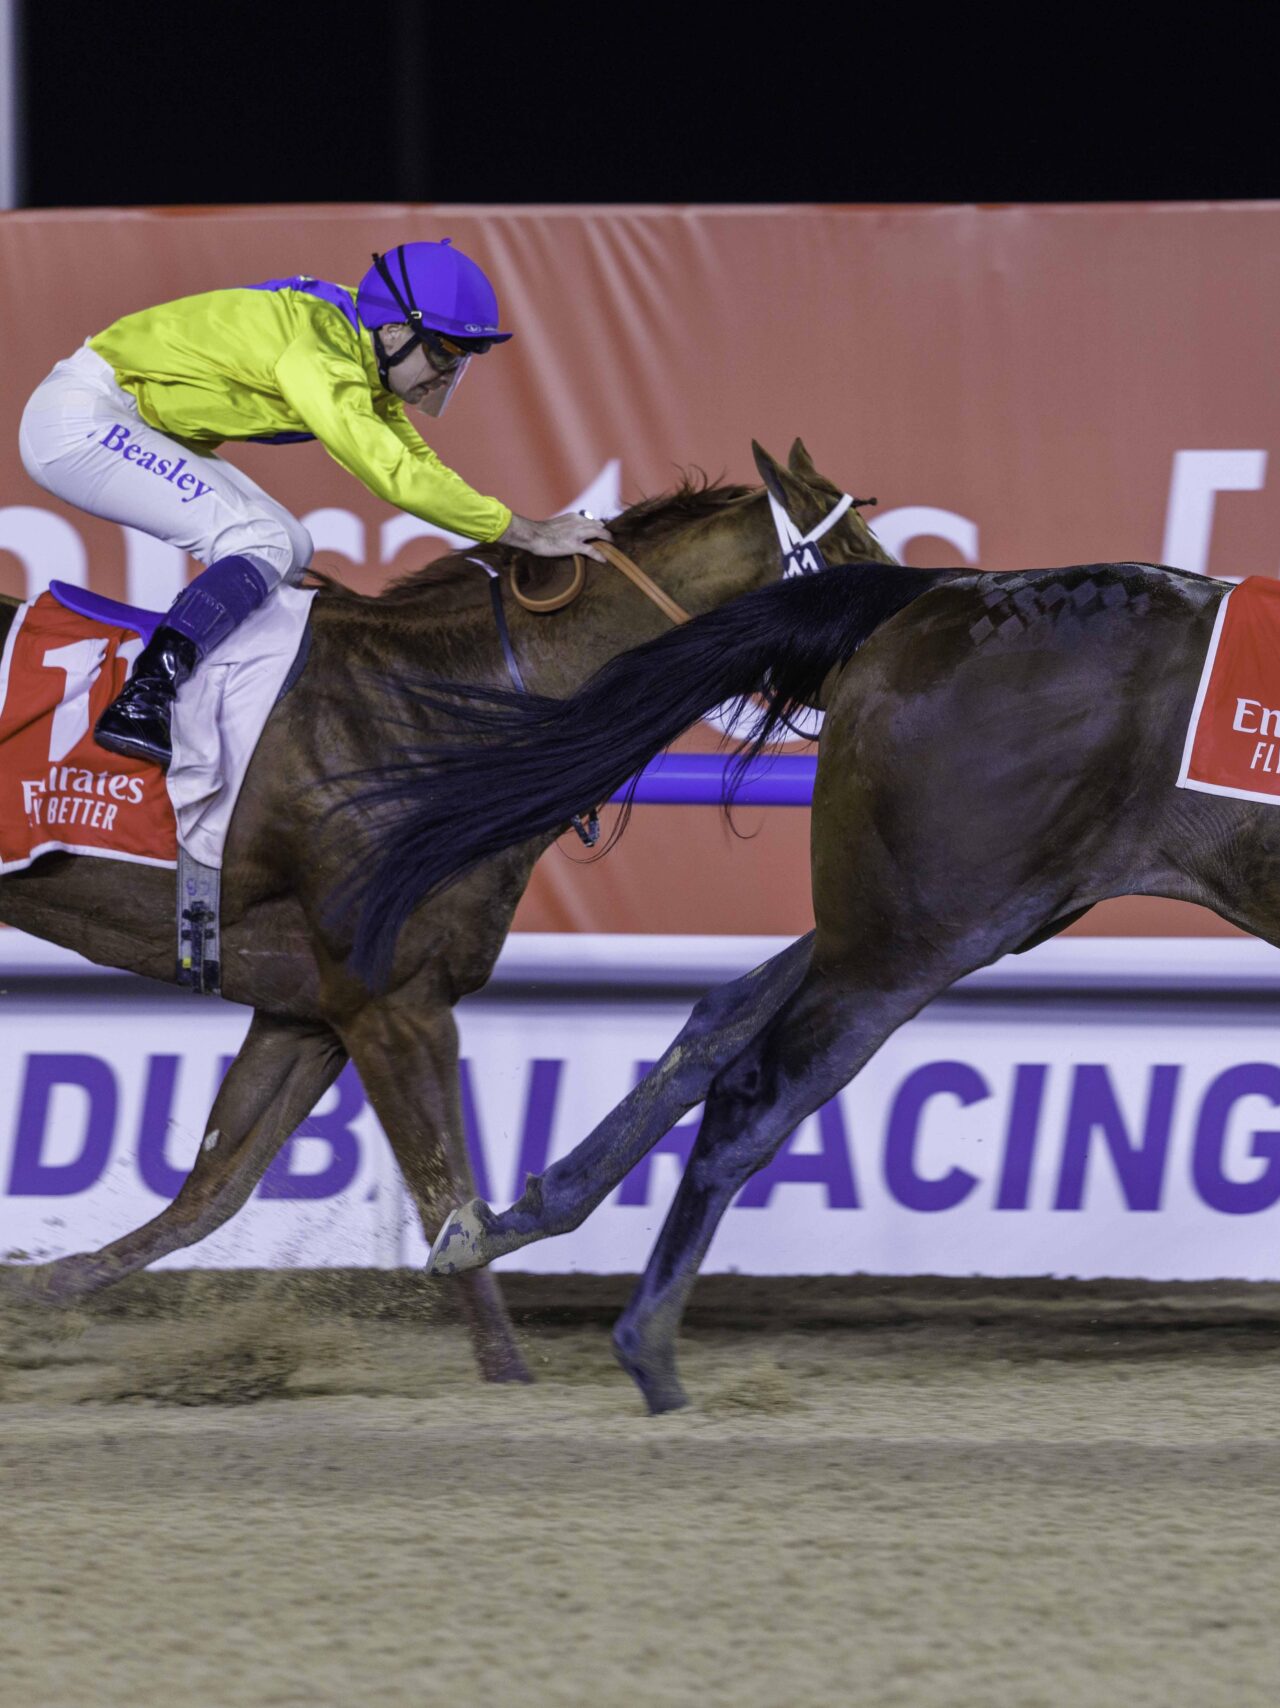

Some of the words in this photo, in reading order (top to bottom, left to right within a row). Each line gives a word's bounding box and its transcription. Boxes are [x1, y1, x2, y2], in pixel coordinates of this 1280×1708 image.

[99, 424, 214, 503] Beasley
[21, 766, 145, 814] Eirates
[47, 796, 119, 831] BETTER
